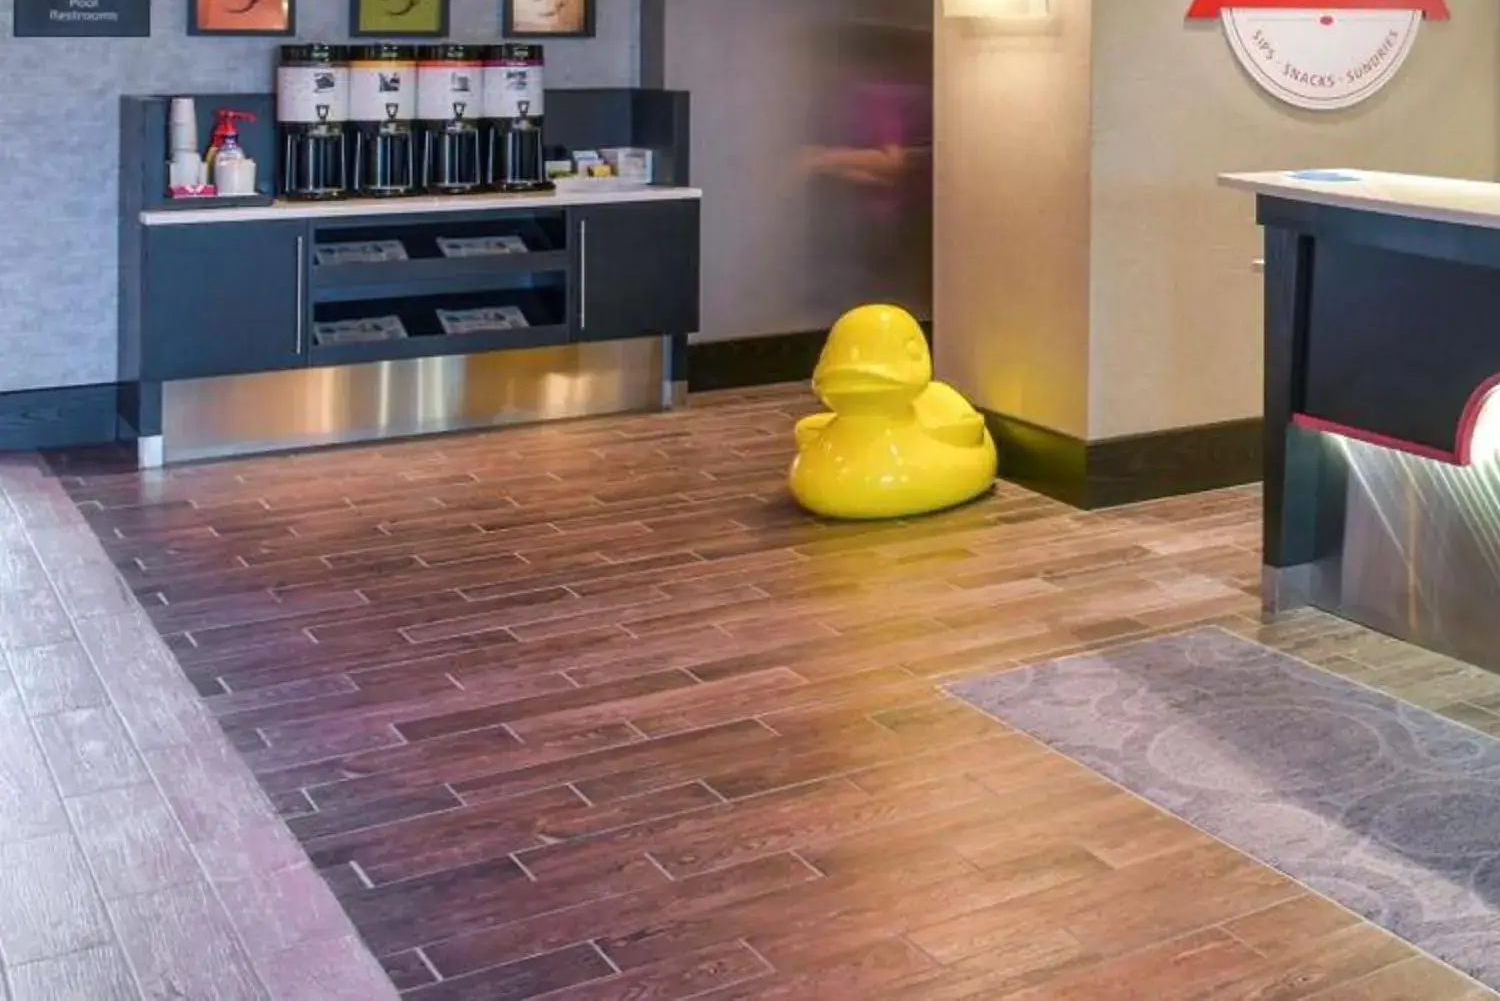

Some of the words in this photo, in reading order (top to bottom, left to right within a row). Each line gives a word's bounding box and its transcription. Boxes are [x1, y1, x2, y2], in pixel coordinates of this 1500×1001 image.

[49, 9, 119, 21] Restrooms
[1251, 28, 1275, 61] SIPS
[1282, 62, 1336, 88] SNACKS
[1346, 29, 1400, 85] SUNDRIES
